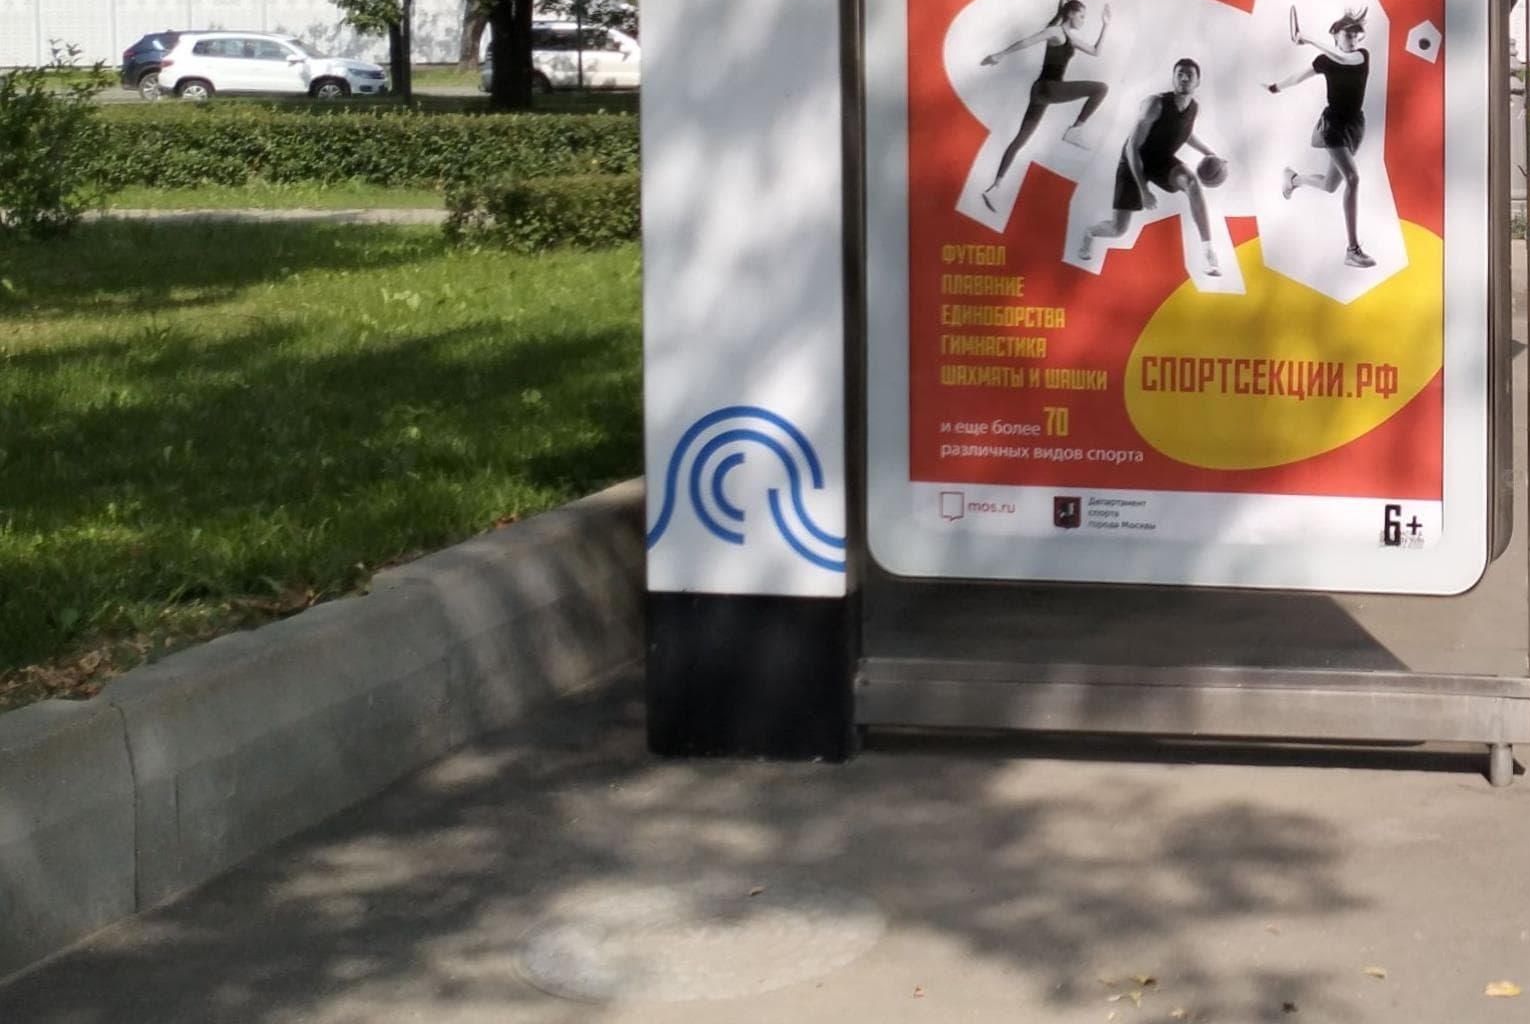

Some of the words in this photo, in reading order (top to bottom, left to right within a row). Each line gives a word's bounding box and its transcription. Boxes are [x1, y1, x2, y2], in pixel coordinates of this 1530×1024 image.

[942, 242, 1006, 266] ФУТБОЛ
[942, 274, 1024, 297] ПЛАВАНИЕ
[942, 304, 1066, 328] ЕДИНОБОРСТВА
[942, 335, 1047, 358] ГИМНАСТИКА
[941, 365, 1024, 388] ШАХМАТЫ
[1030, 368, 1040, 388] И
[1045, 369, 1108, 390] ШАШКИ
[1142, 356, 1399, 400] СПОРТСЕКЦИИ.РФ
[941, 422, 951, 432] и
[955, 421, 987, 435] еще
[992, 419, 1041, 436] более
[1044, 407, 1069, 436] 70
[941, 444, 1029, 458] различных
[1034, 449, 1083, 461] видов
[1087, 450, 1144, 464] спорта
[968, 500, 1016, 513] mos.ru
[1385, 504, 1423, 546] 6+
